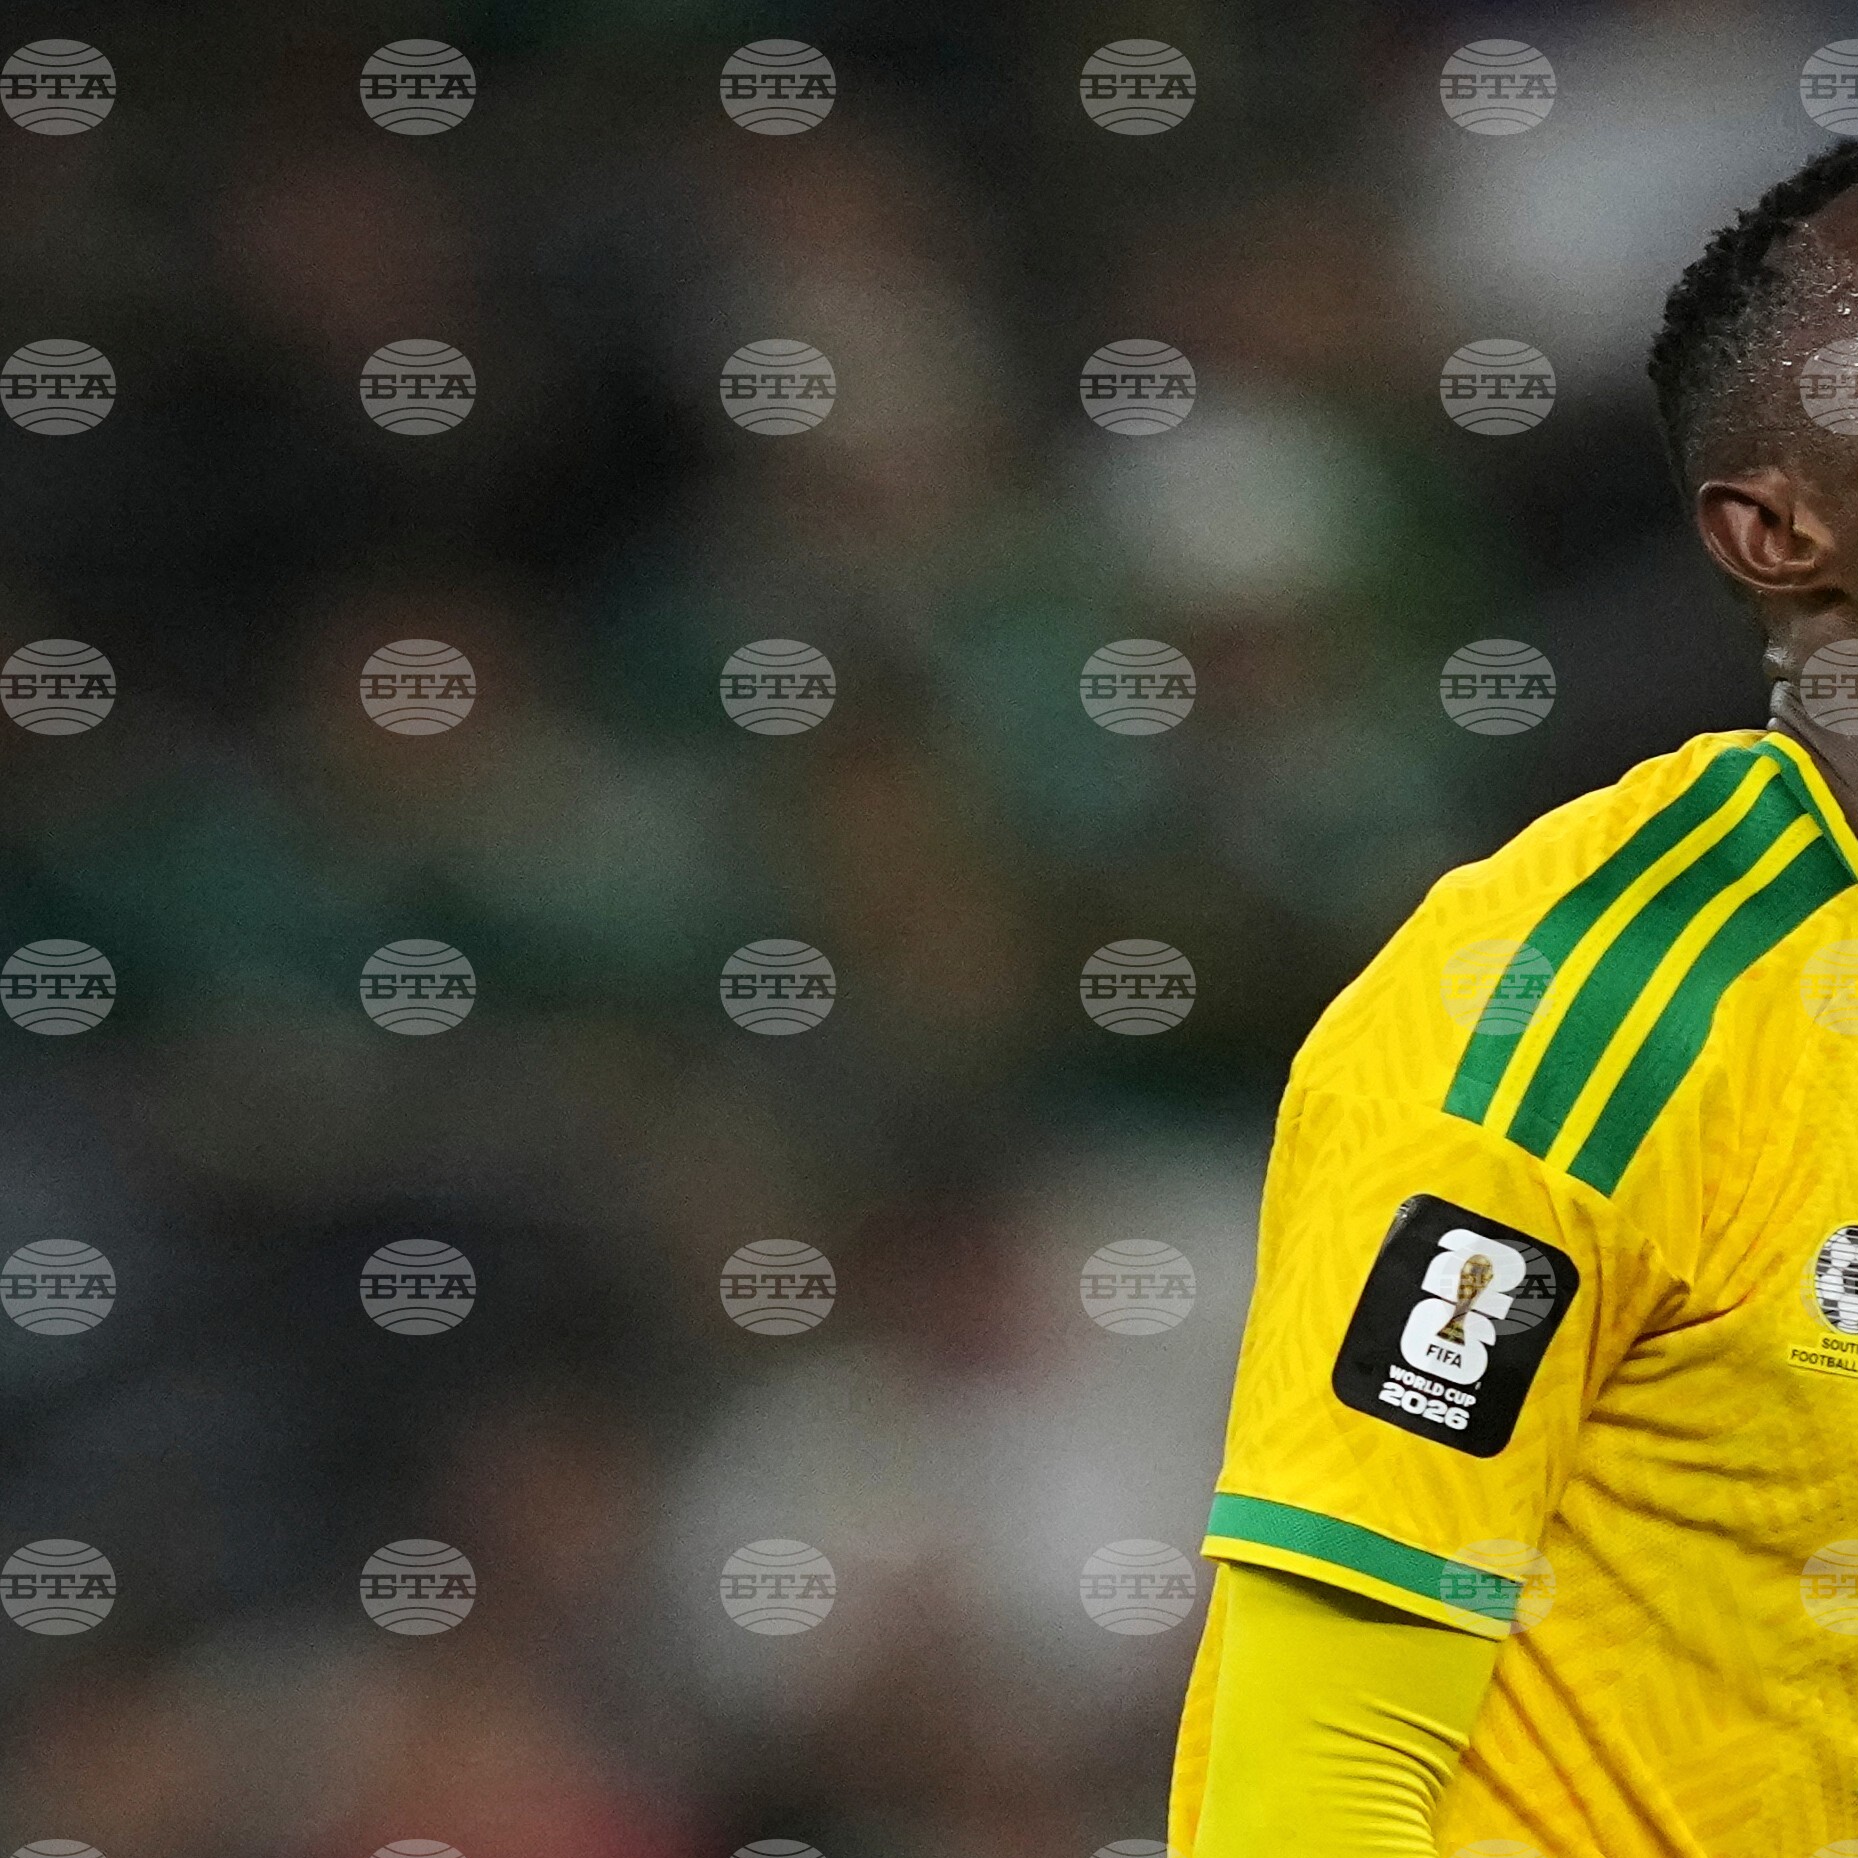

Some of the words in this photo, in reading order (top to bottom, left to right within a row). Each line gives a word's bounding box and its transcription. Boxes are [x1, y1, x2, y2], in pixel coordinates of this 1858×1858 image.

[1426, 1344, 1463, 1369] FIFA
[1790, 1349, 1858, 1373] FOOTBALL
[1389, 1364, 1444, 1397] WORLD
[1444, 1387, 1477, 1408] CUP
[1378, 1381, 1470, 1431] 2026
